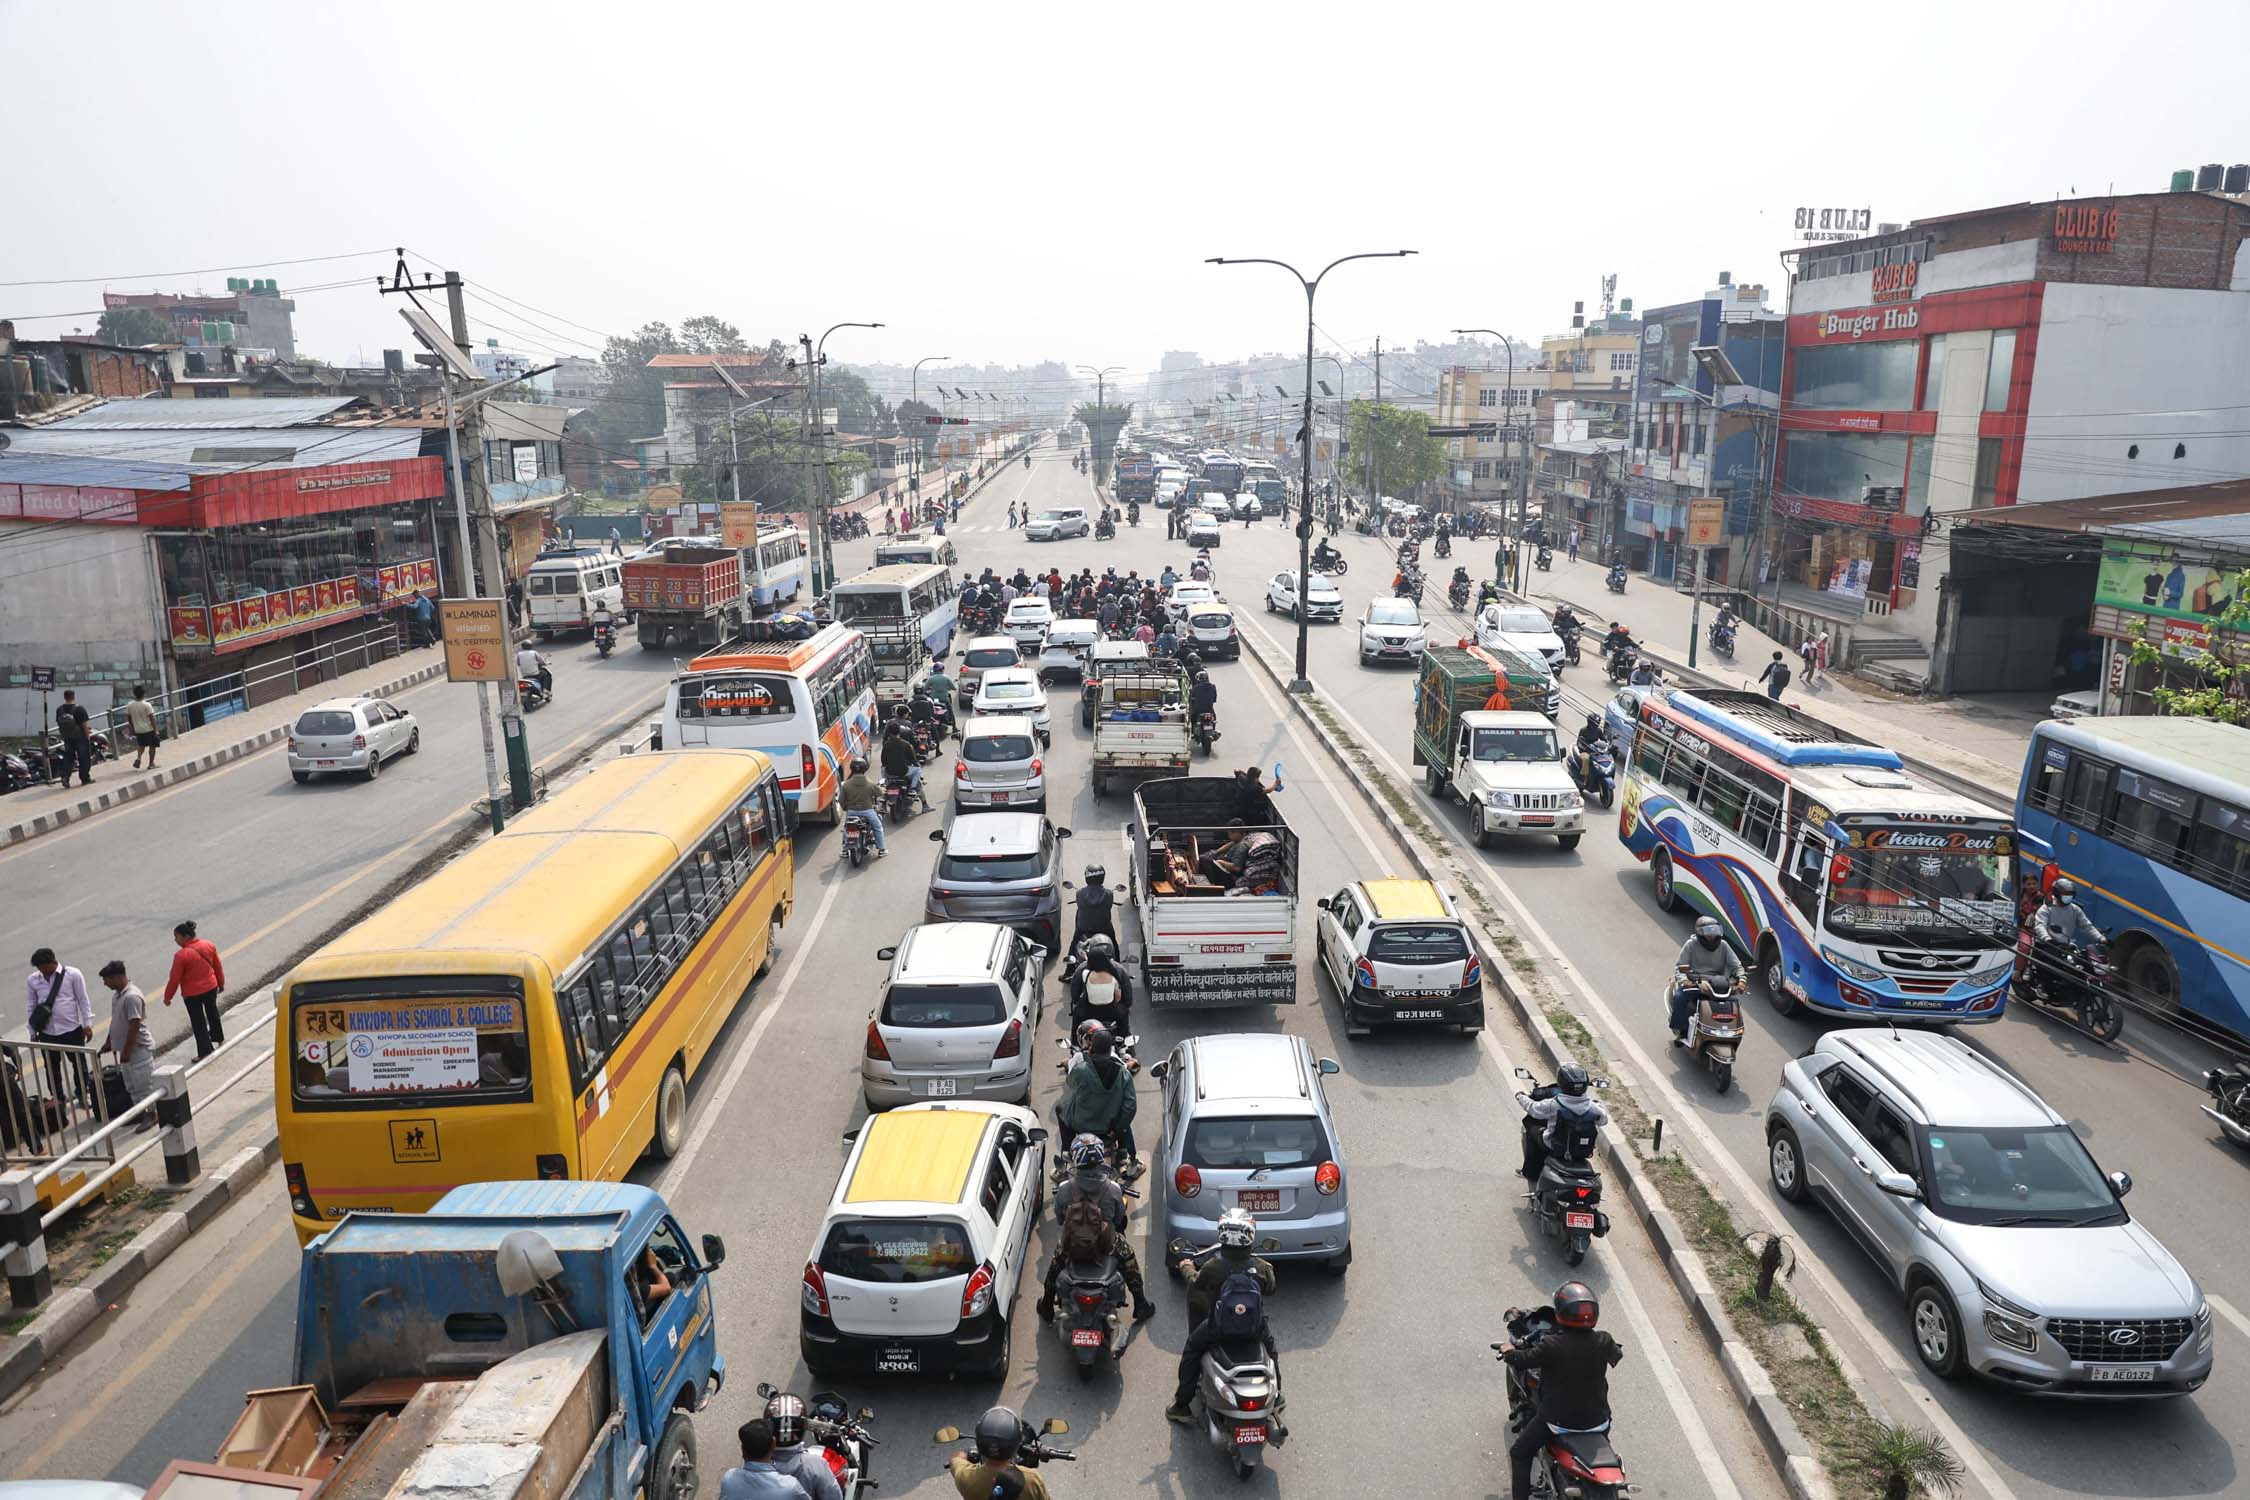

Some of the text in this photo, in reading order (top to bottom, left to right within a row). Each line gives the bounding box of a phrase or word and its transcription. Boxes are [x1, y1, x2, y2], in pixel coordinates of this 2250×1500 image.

[2055, 205, 2120, 240] CLUB 18
[1871, 259, 1917, 292] CLUB 18
[1827, 306, 1919, 338] Burger Hub
[68, 490, 133, 513] Chicken
[453, 609, 497, 619] LAMINAR
[2109, 651, 2124, 696] MRF
[1896, 812, 1967, 824] VOLVO
[1947, 831, 1994, 849] Devi
[349, 1004, 513, 1031] KHWOPA HS SCHOOL & COLLEGE
[408, 1032, 446, 1040] SECONDARY
[307, 1044, 321, 1060] C
[382, 1045, 470, 1057] Admission Open
[2102, 1371, 2109, 1380] B
